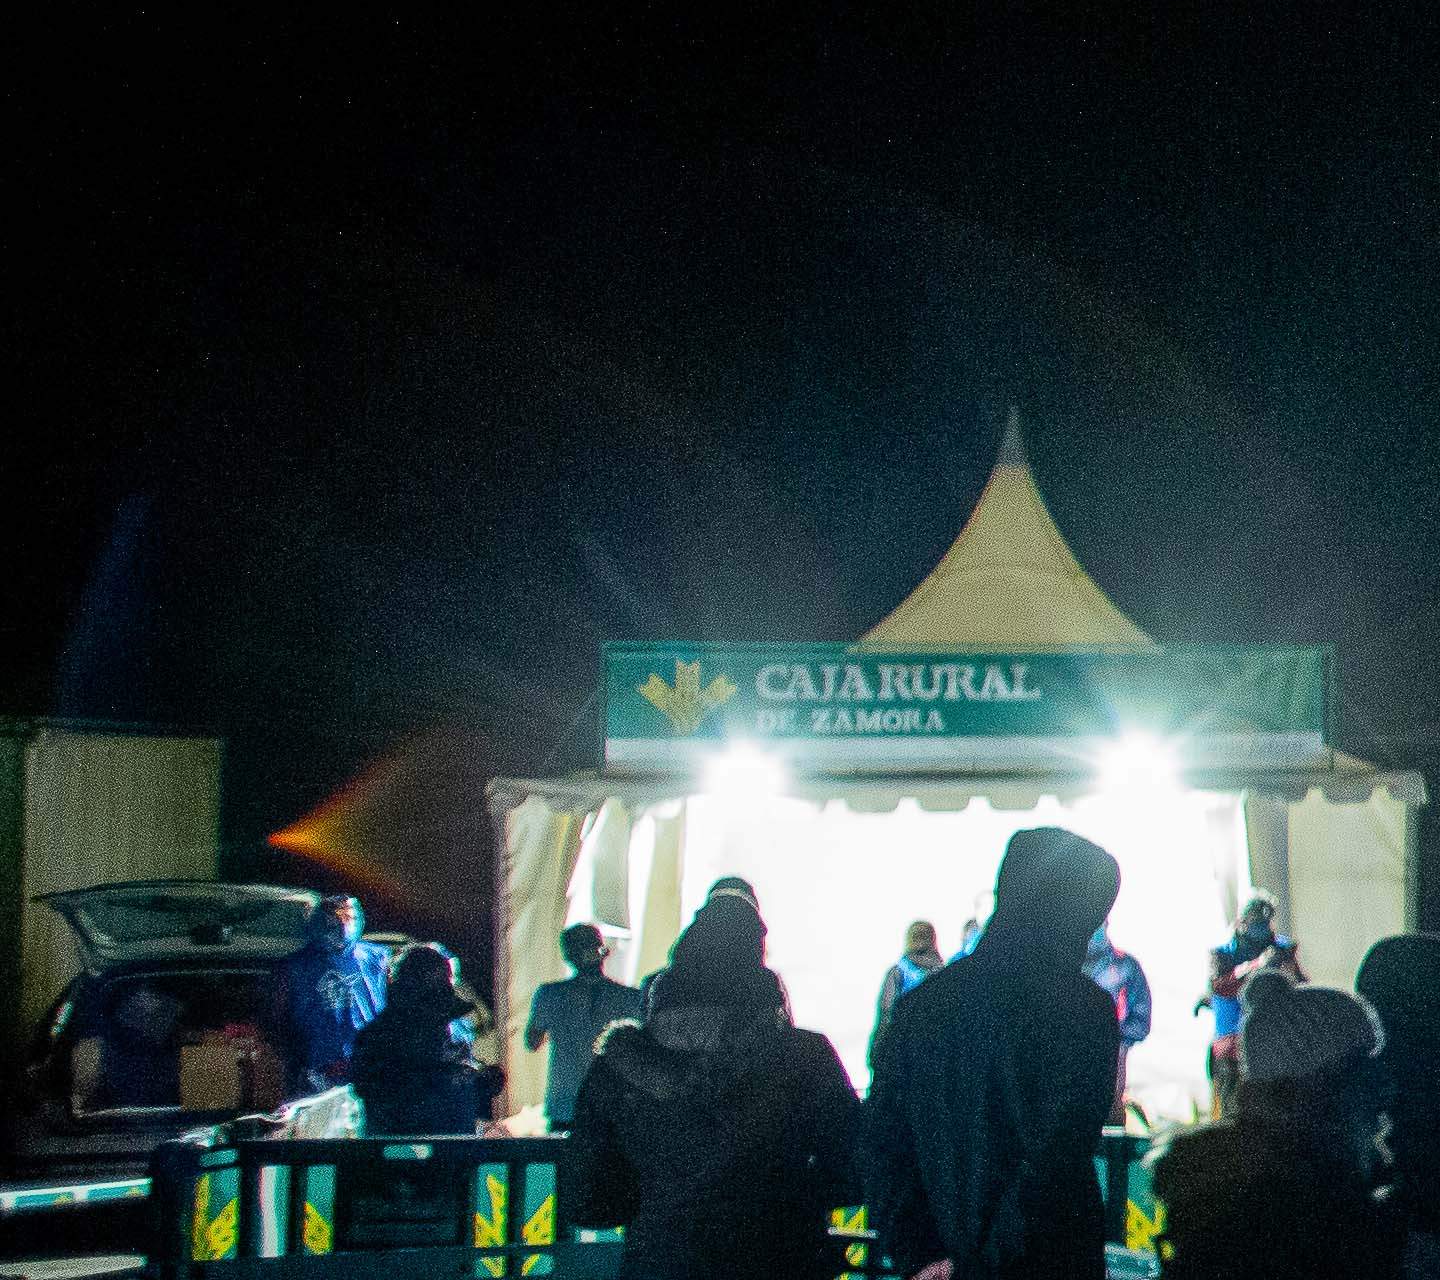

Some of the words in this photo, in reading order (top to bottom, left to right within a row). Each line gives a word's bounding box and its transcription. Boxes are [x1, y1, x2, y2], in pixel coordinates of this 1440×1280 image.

[754, 663, 872, 702] CAJA
[879, 662, 1042, 701] RURAL
[812, 708, 945, 733] ZAMORA
